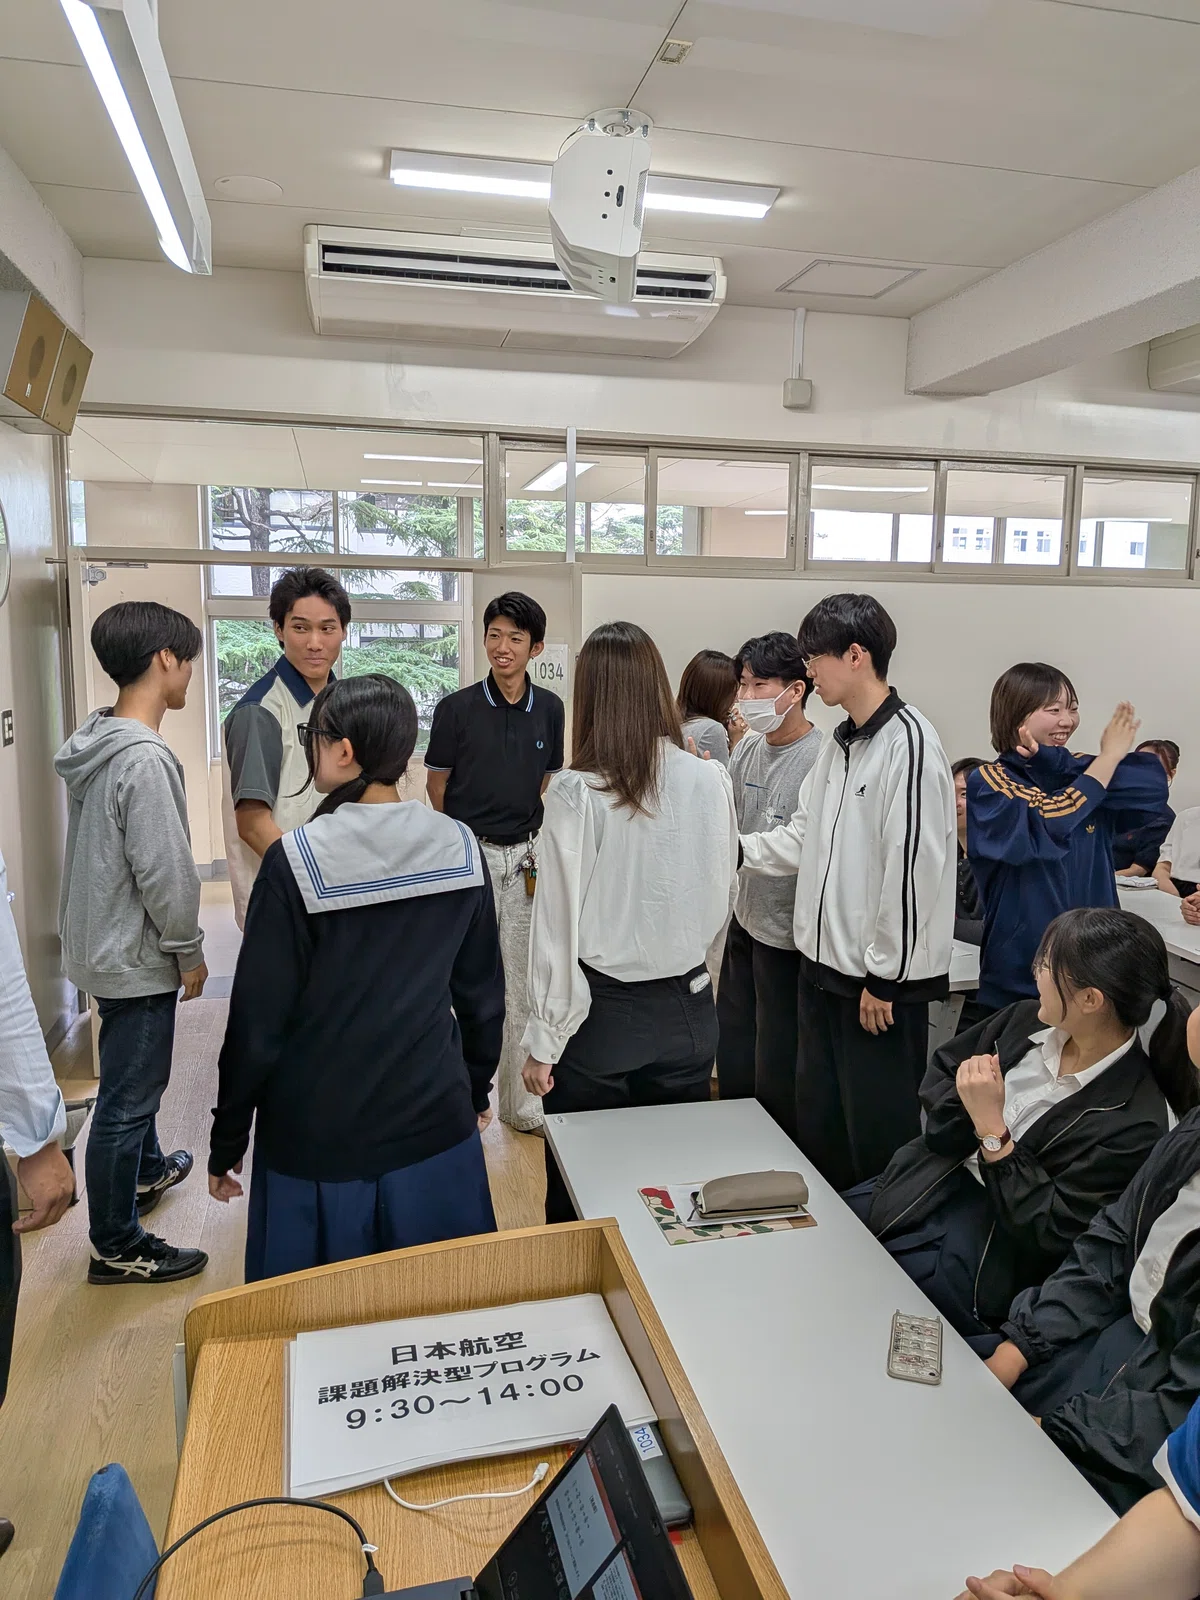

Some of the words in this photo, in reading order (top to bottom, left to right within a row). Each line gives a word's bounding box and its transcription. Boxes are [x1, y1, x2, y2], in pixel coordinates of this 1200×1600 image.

[534, 661, 564, 681] 1034
[392, 1332, 528, 1365] 日本航空
[318, 1349, 601, 1404] 課題解決型プログラム
[634, 1427, 656, 1453] 1034
